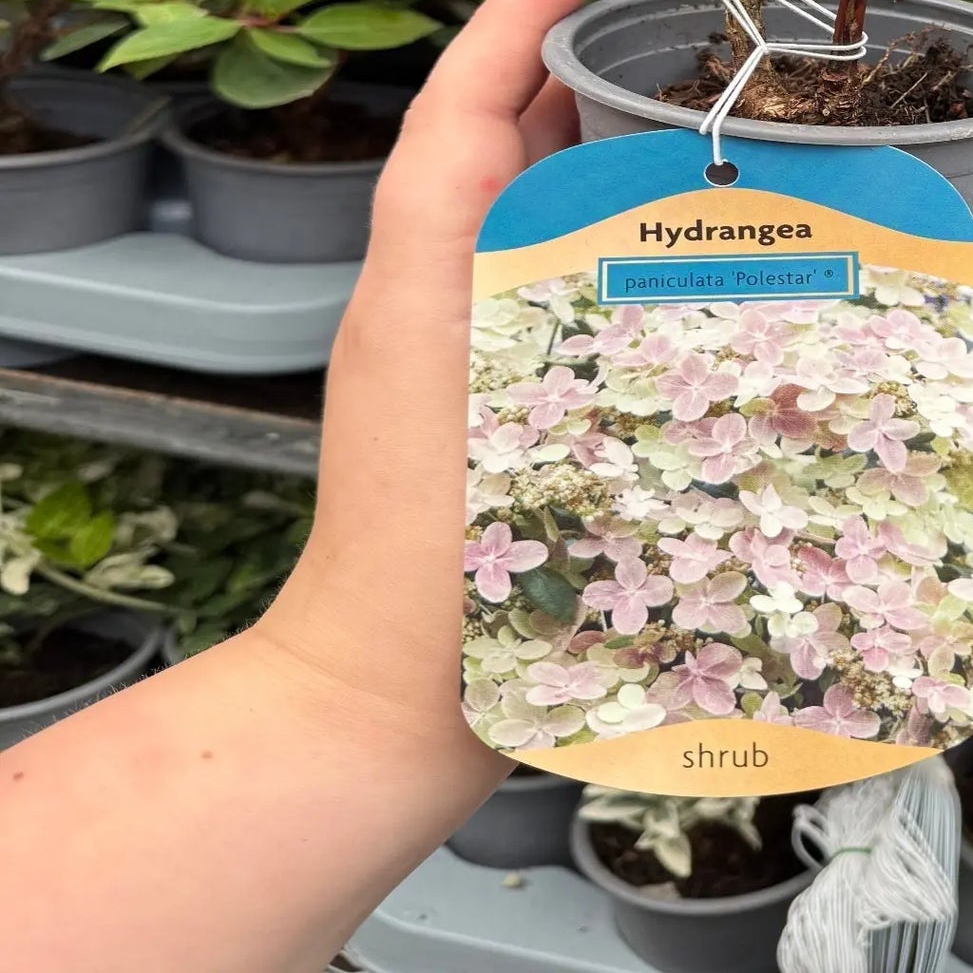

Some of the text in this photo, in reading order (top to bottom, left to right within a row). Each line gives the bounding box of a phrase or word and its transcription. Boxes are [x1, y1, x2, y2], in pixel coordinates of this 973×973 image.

[639, 218, 813, 249] Hydrangea
[624, 271, 725, 293] paniculata
[731, 268, 817, 288] 'Polestar'
[682, 741, 769, 768] shrub
